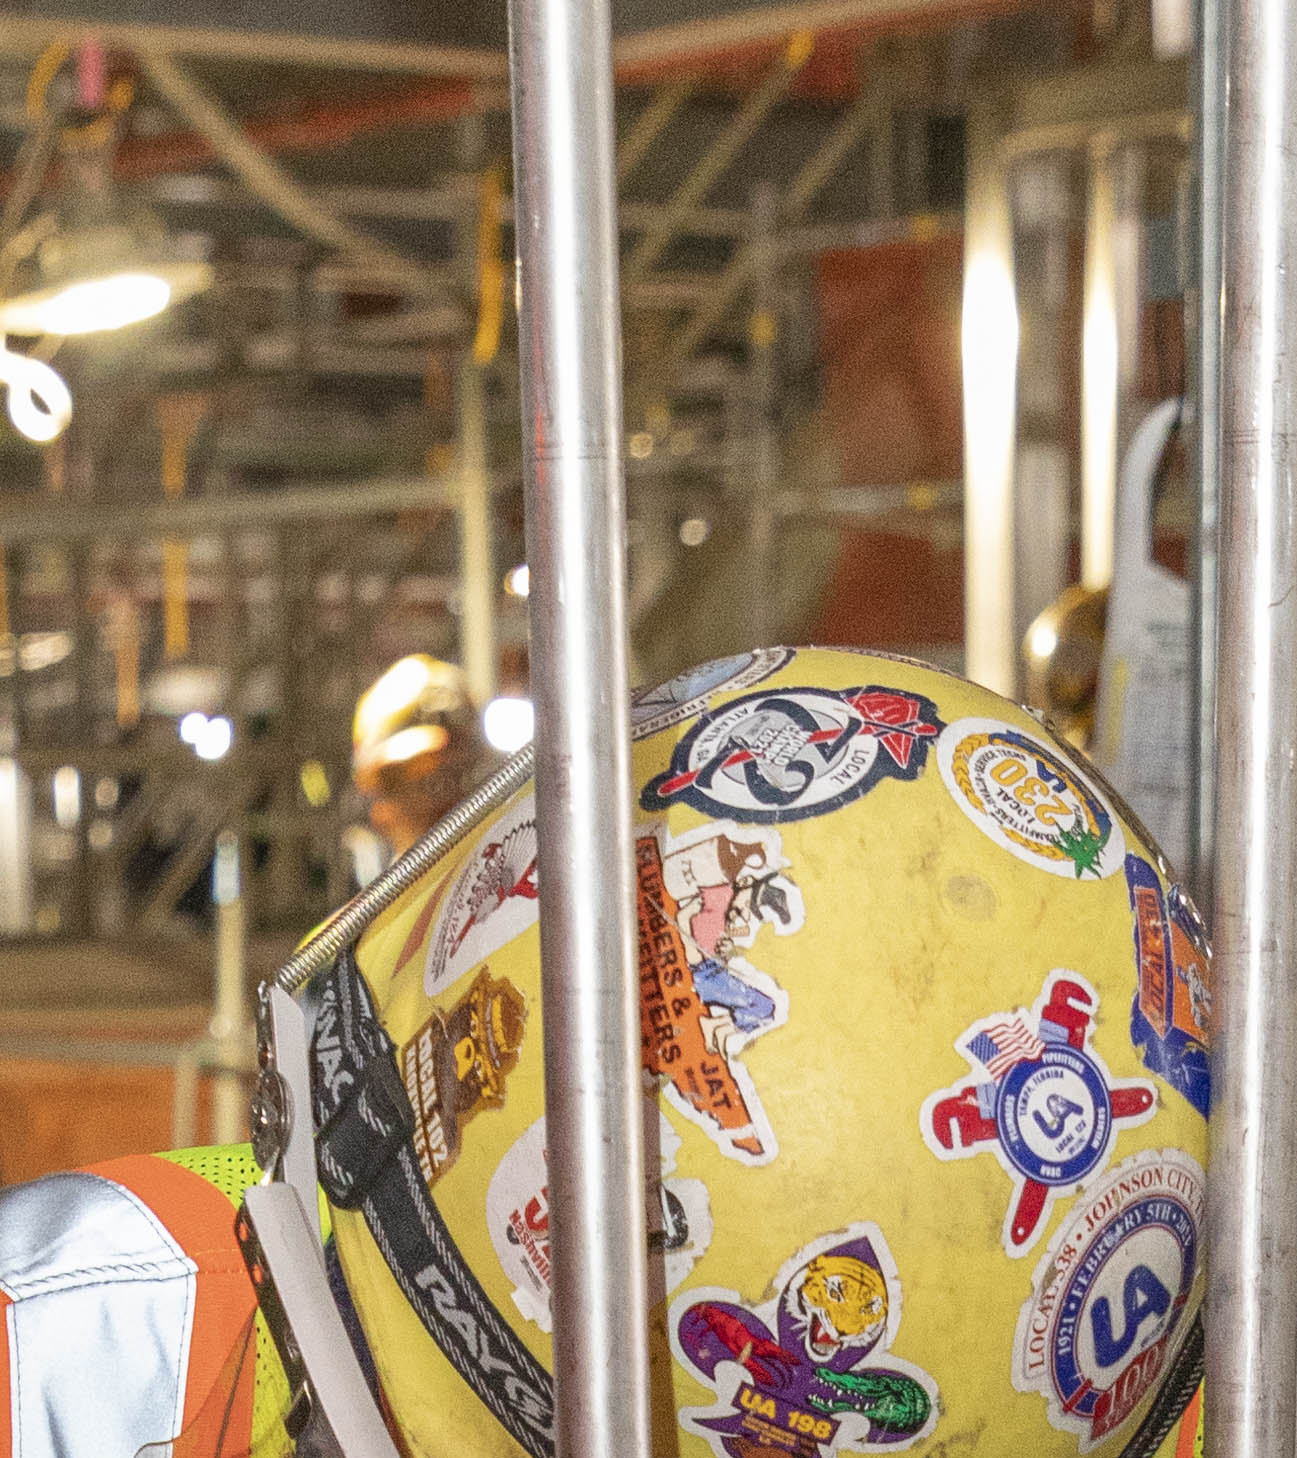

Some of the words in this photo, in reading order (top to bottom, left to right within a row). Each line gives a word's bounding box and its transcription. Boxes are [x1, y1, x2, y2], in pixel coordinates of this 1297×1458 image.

[830, 749, 870, 786] LOCAL
[990, 759, 1073, 826] 230
[997, 787, 1036, 824] LOCAL
[671, 998, 691, 1017] &
[700, 1061, 732, 1111] JAT
[426, 1109, 449, 1168] 102
[1056, 1134, 1075, 1153] LOCAL
[1029, 1286, 1058, 1370] LOCAL
[1083, 1165, 1164, 1232] JOHNSON
[1058, 1317, 1075, 1355] 1921
[1071, 1209, 1144, 1297] FEBRUARY
[1145, 1202, 1172, 1222] 5TH
[1090, 1264, 1172, 1368] UA
[740, 1388, 776, 1419] UA
[788, 1410, 833, 1440] 198
